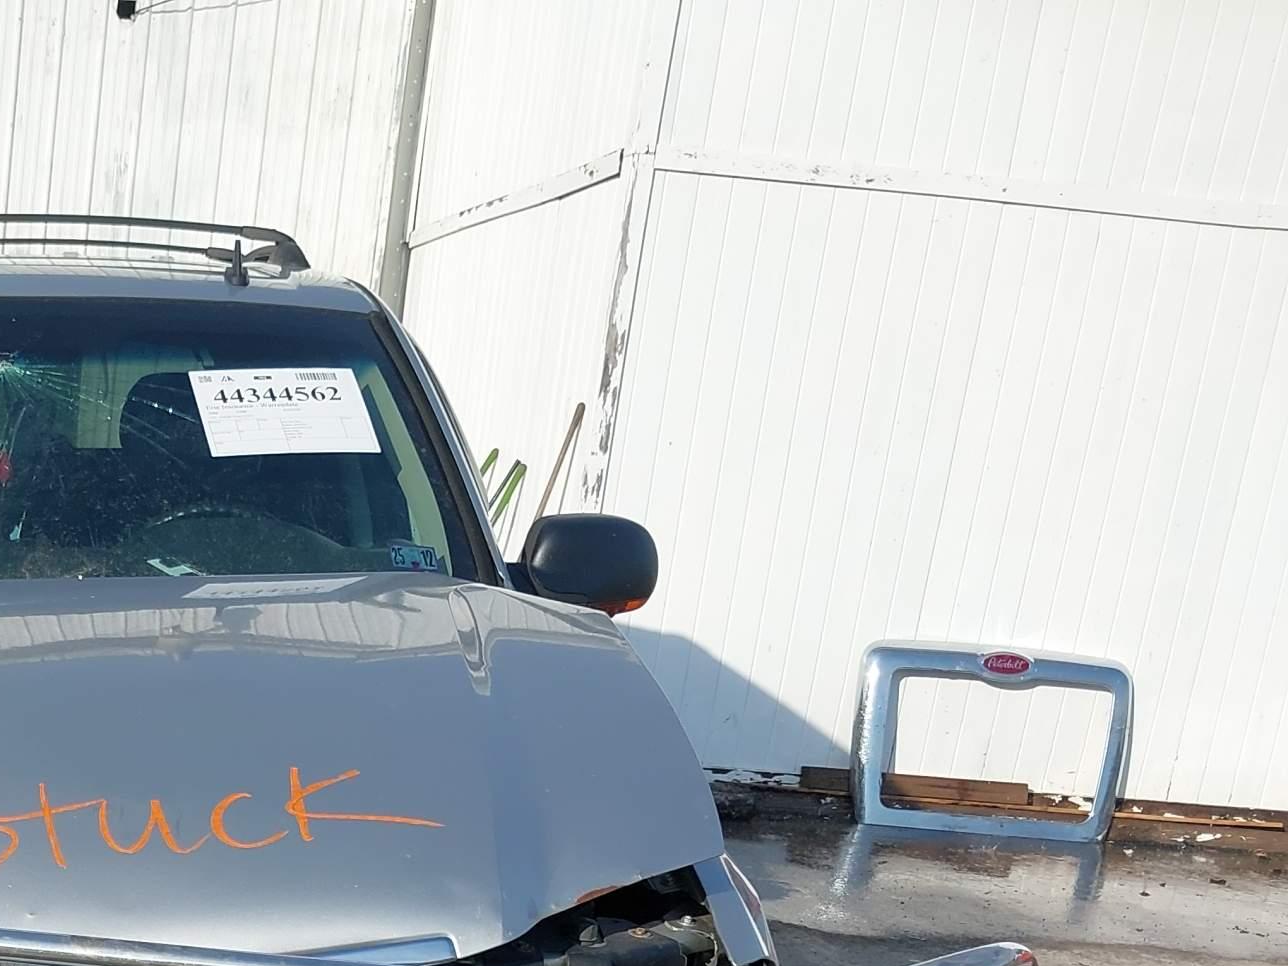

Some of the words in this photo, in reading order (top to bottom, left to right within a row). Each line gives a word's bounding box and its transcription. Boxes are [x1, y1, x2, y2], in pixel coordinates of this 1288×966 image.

[214, 386, 342, 404] 44344562
[392, 547, 406, 566] 25
[420, 550, 436, 568] 12
